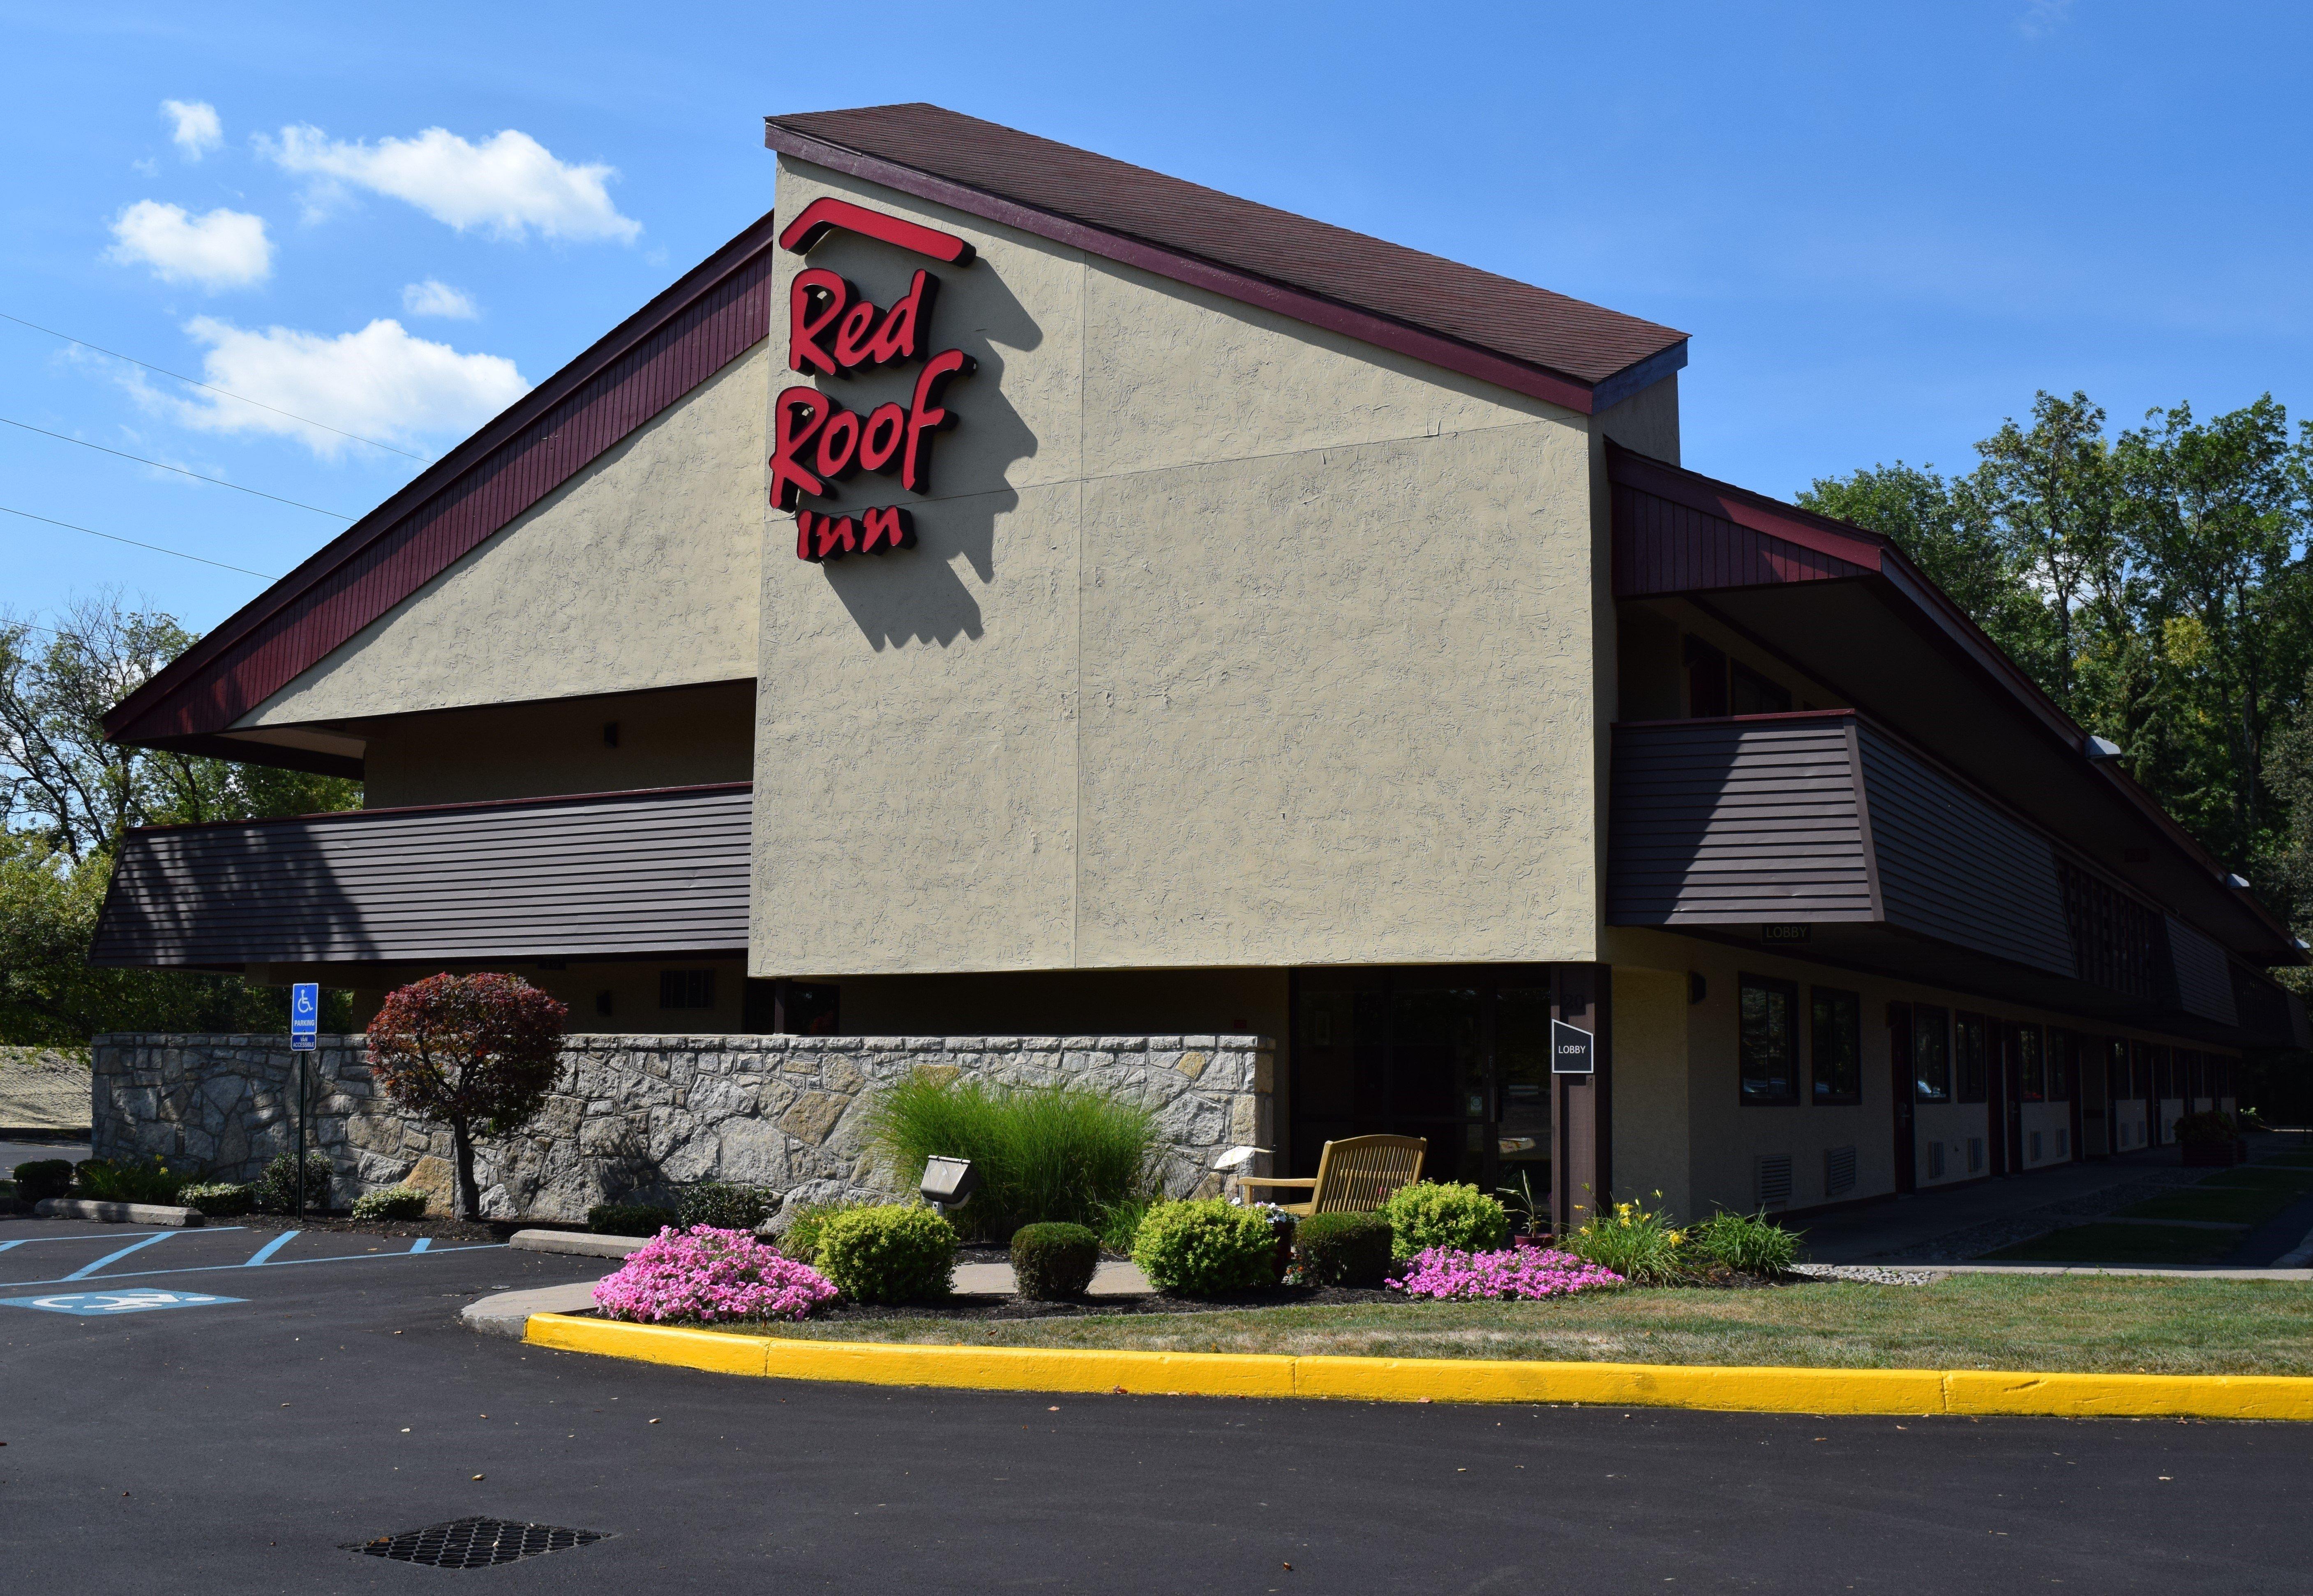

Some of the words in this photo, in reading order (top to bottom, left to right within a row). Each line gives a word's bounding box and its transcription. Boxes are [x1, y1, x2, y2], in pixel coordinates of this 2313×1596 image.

[789, 268, 926, 376] Red
[769, 348, 964, 510] Roof
[796, 505, 903, 560] Inn
[1766, 926, 1807, 938] LOBBY
[1558, 1045, 1586, 1054] LOBBY
